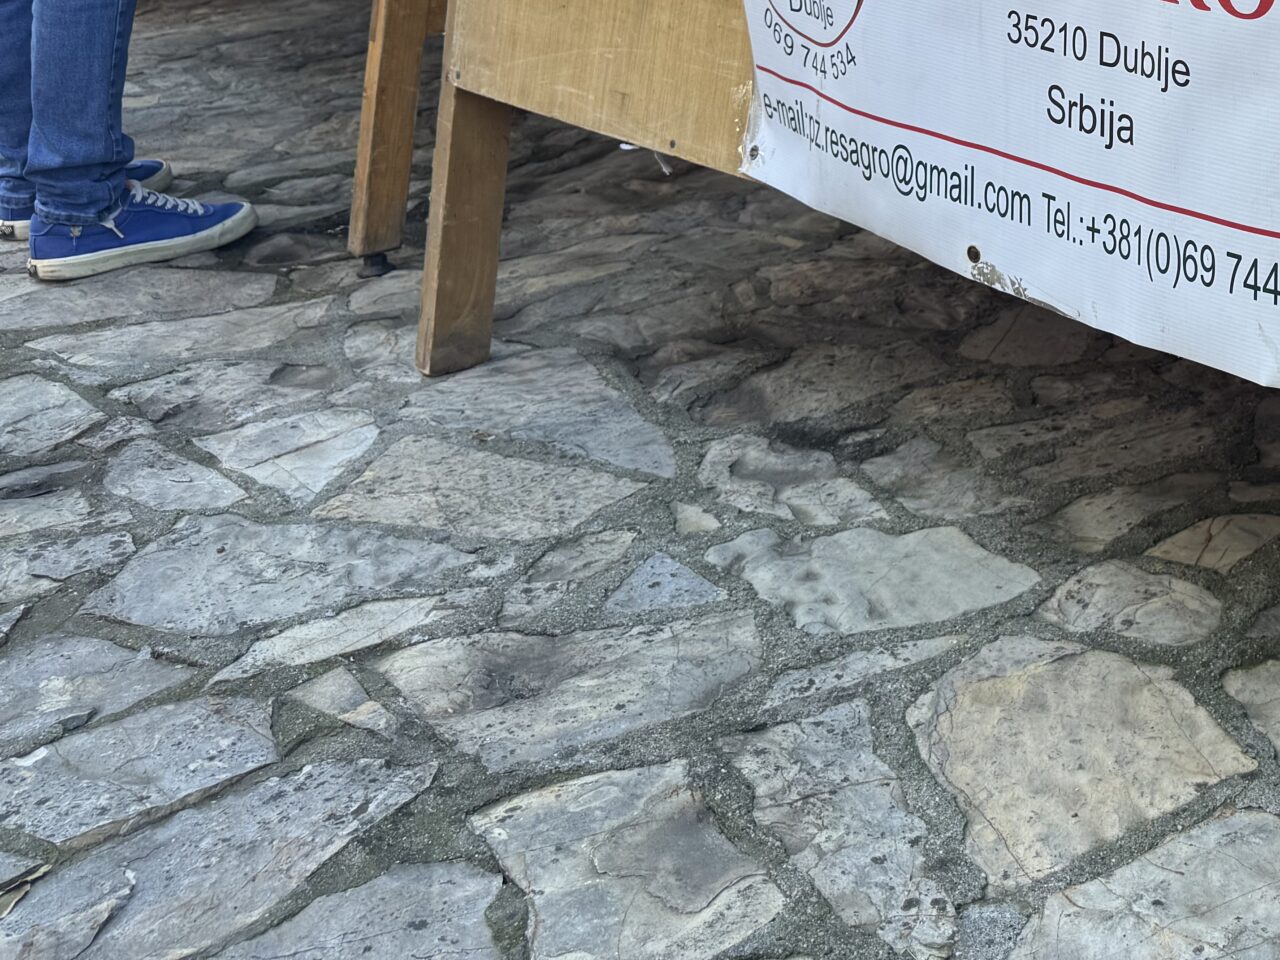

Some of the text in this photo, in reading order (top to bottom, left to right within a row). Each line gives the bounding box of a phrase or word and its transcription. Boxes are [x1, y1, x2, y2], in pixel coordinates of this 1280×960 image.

[764, 7, 857, 80] 069 744 534
[1007, 9, 1191, 93] 35210 Dublje
[1047, 84, 1134, 150] Srbija
[763, 92, 1032, 227] e-mail:pz.resagro@gmail.com
[1042, 191, 1216, 289] Tel.:+381(0)69
